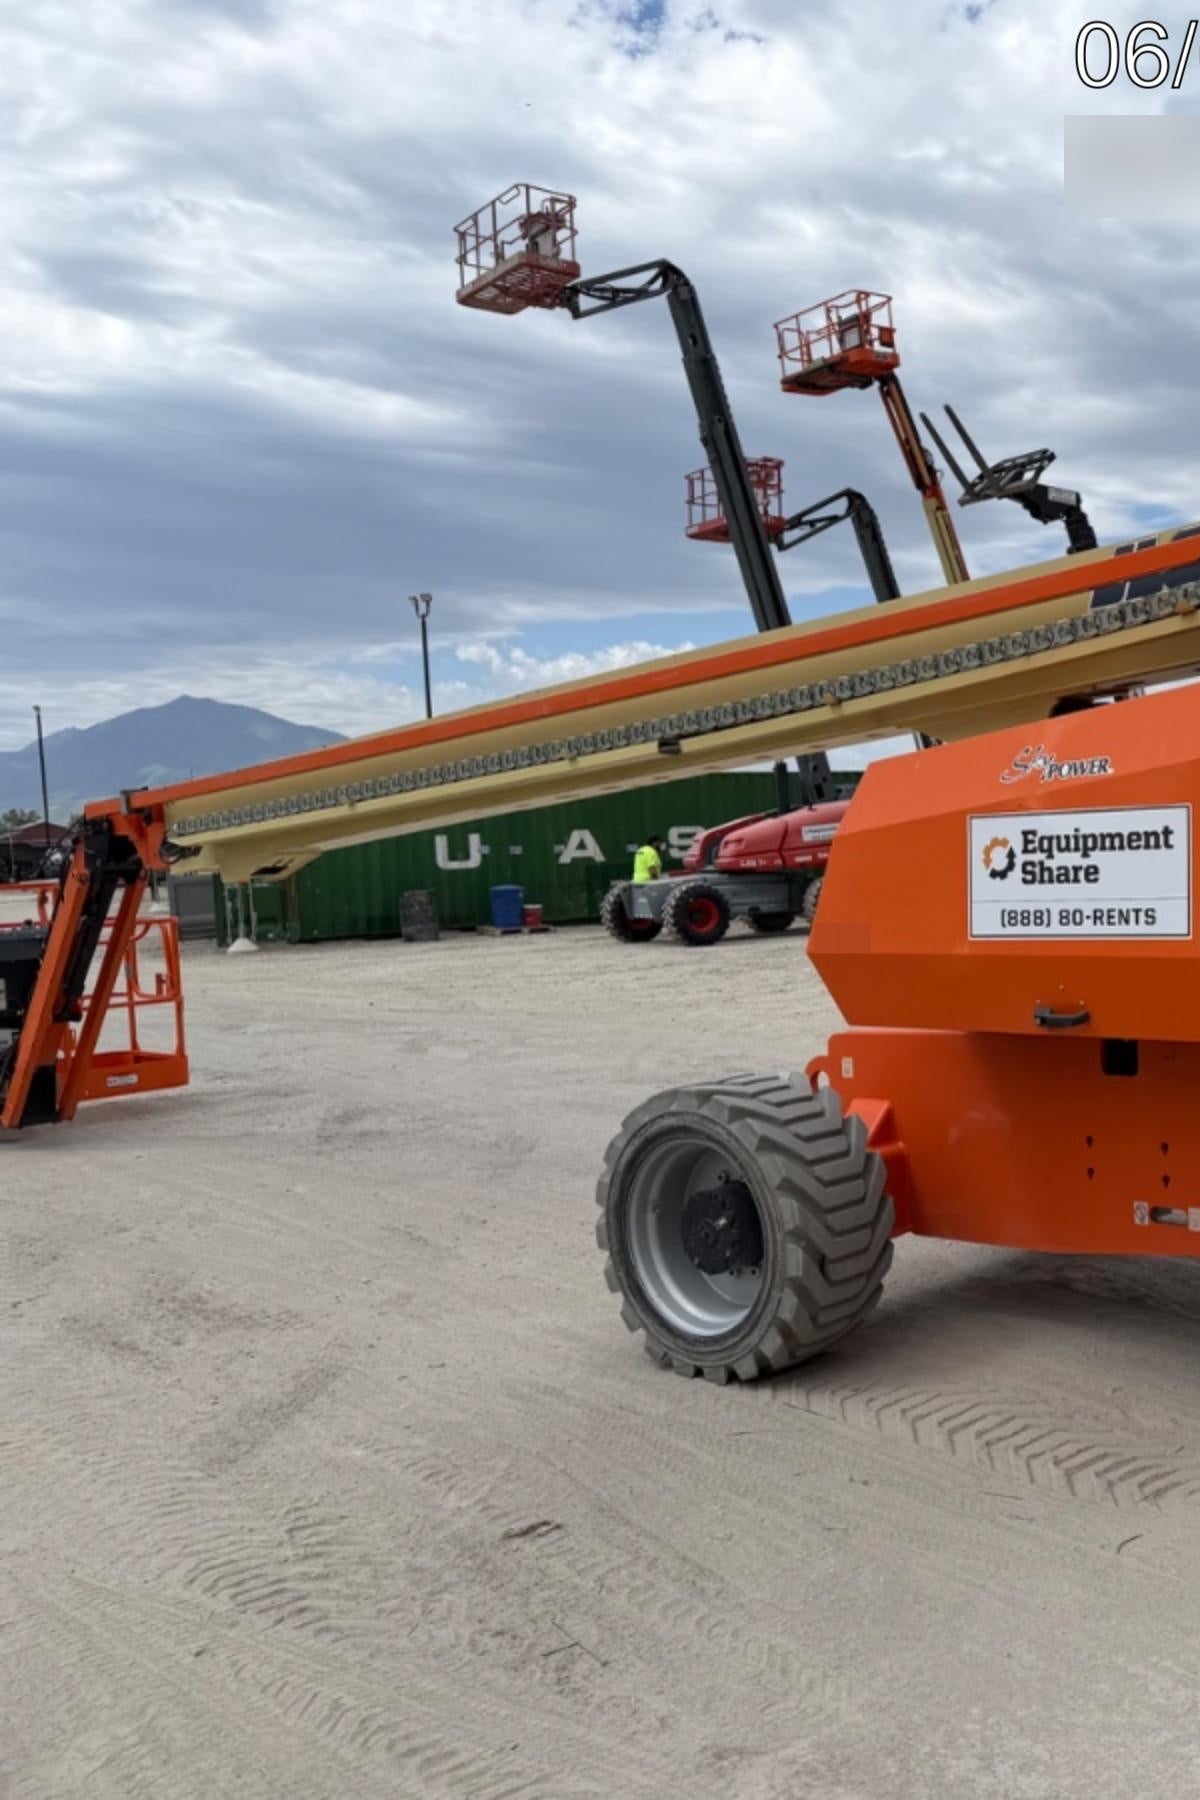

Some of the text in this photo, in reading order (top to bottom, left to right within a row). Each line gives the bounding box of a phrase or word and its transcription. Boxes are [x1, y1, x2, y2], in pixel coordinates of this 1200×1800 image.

[1020, 824, 1175, 860] Equipment
[1020, 860, 1101, 885] Share
[1000, 907, 1157, 929] (888) 80-RENTS
